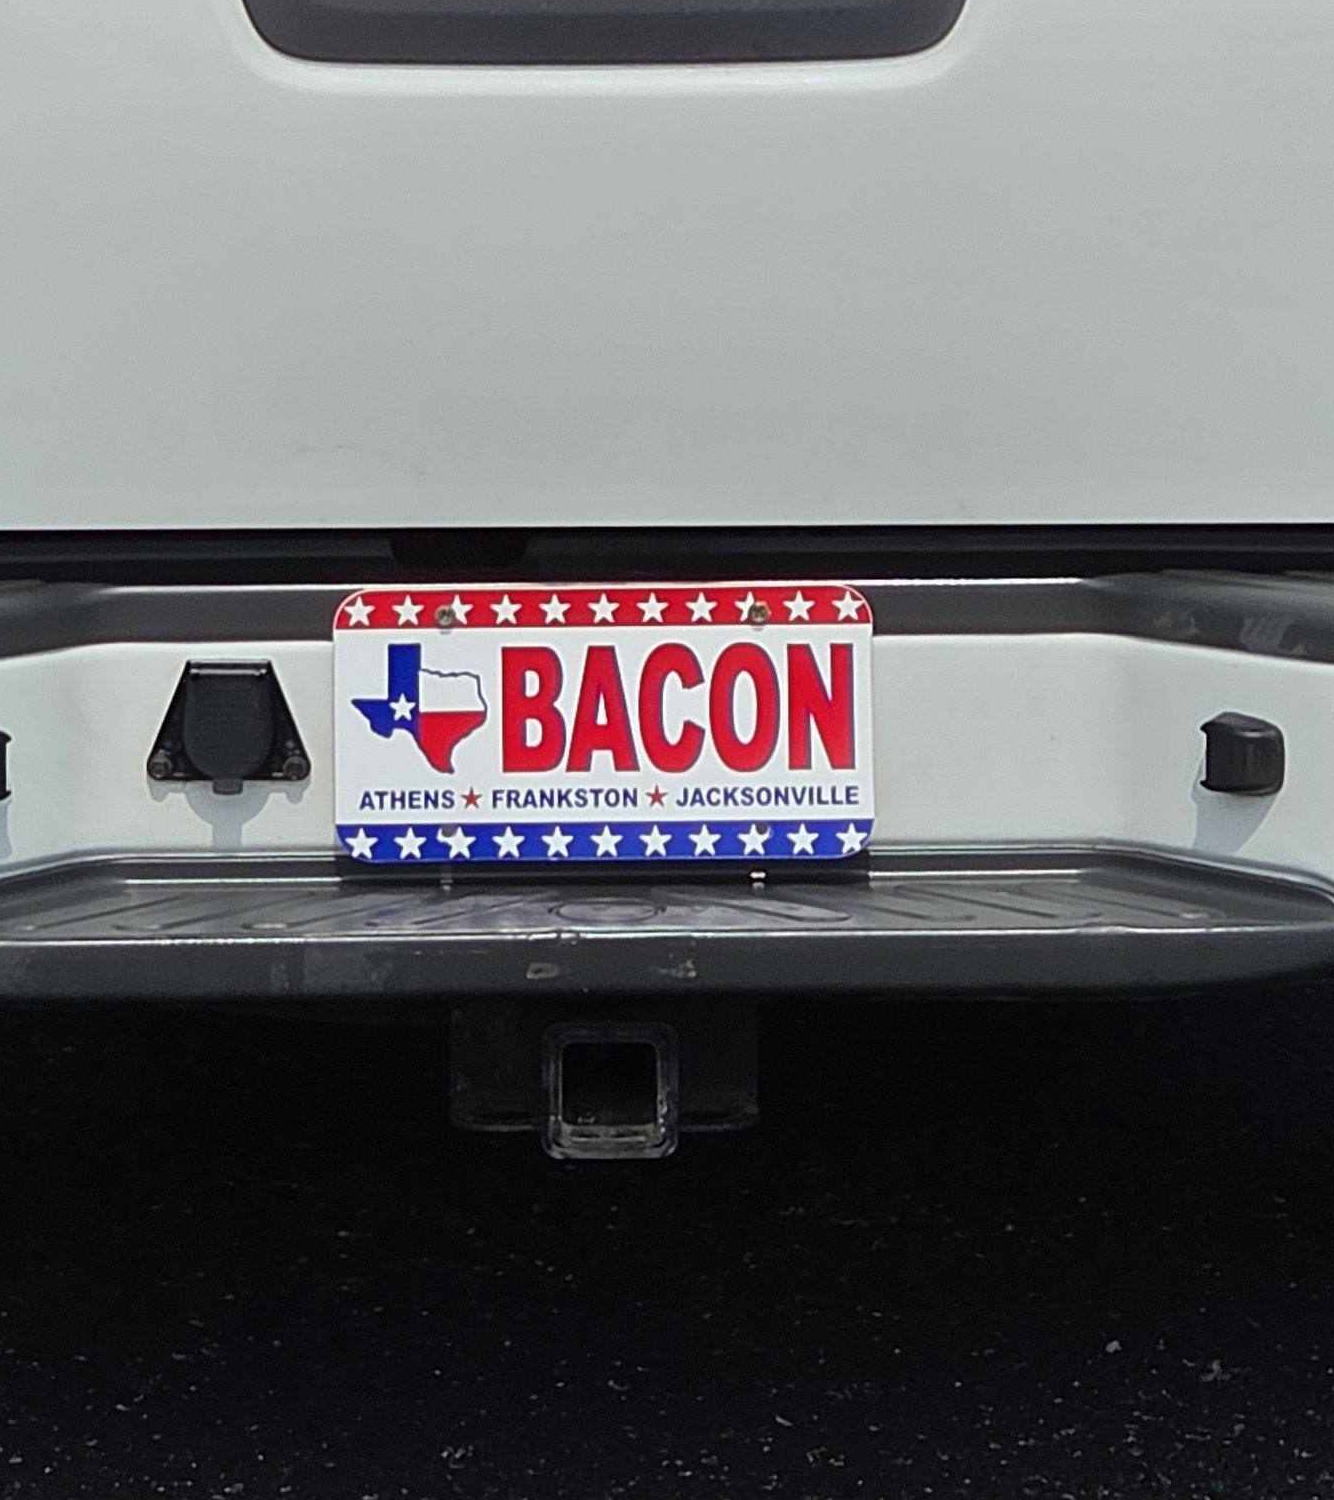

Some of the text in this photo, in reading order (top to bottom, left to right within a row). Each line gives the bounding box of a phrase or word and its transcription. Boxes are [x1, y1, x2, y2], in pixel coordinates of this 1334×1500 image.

[500, 642, 857, 774] BACON
[359, 786, 859, 810] ATHENS FRANKSTON JACKSONVILLE
